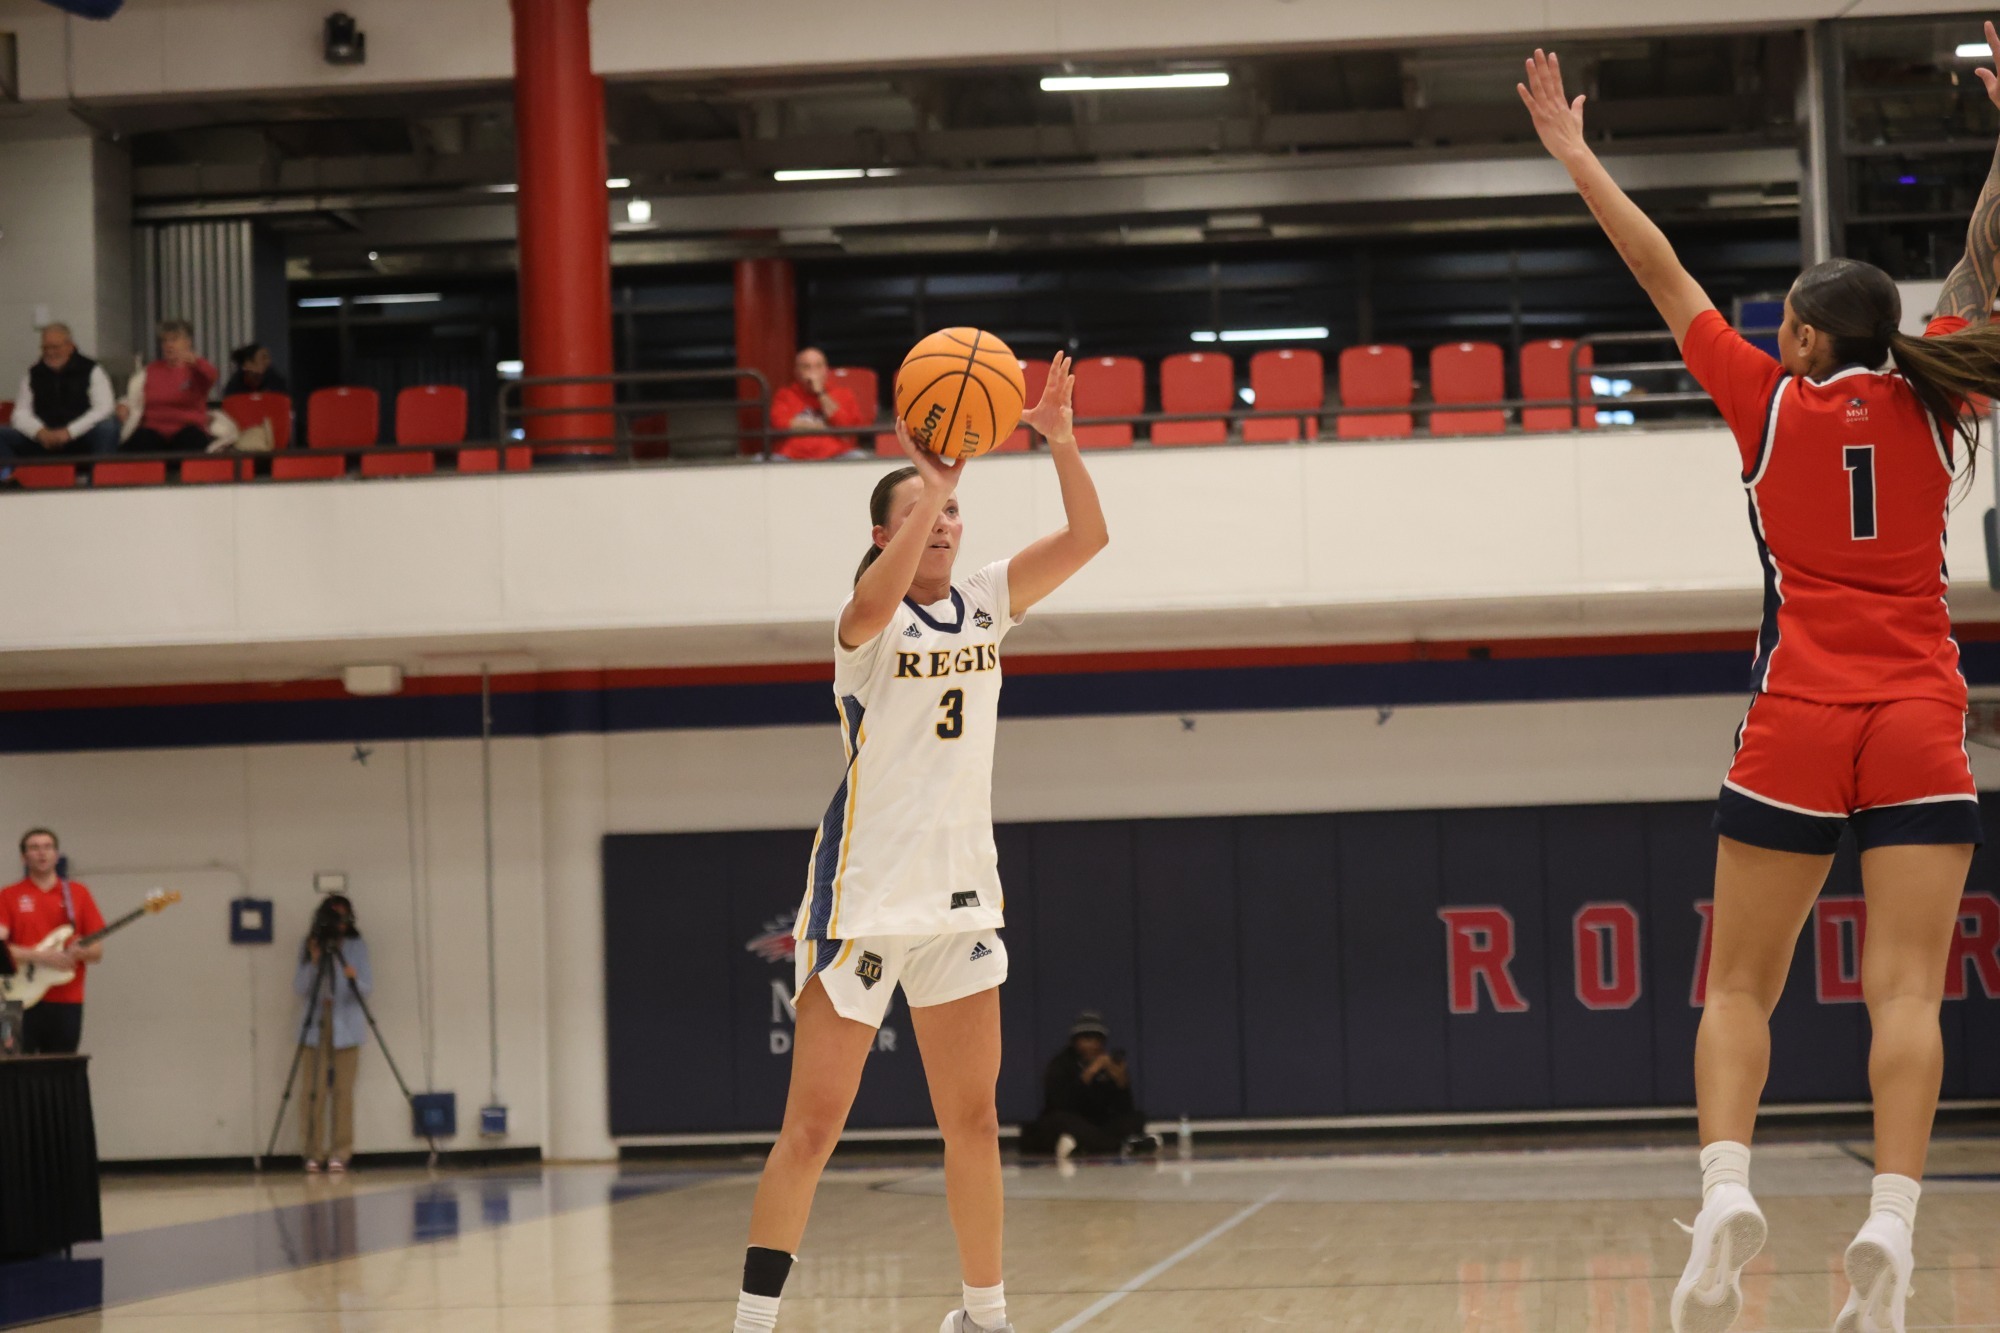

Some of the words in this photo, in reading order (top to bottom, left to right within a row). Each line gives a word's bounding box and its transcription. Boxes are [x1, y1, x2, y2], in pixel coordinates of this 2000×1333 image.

[1846, 408, 1868, 417] MSU
[1843, 445, 1877, 541] 1
[894, 643, 997, 679] REGIS
[935, 687, 966, 741] 3
[970, 949, 992, 961] adidas
